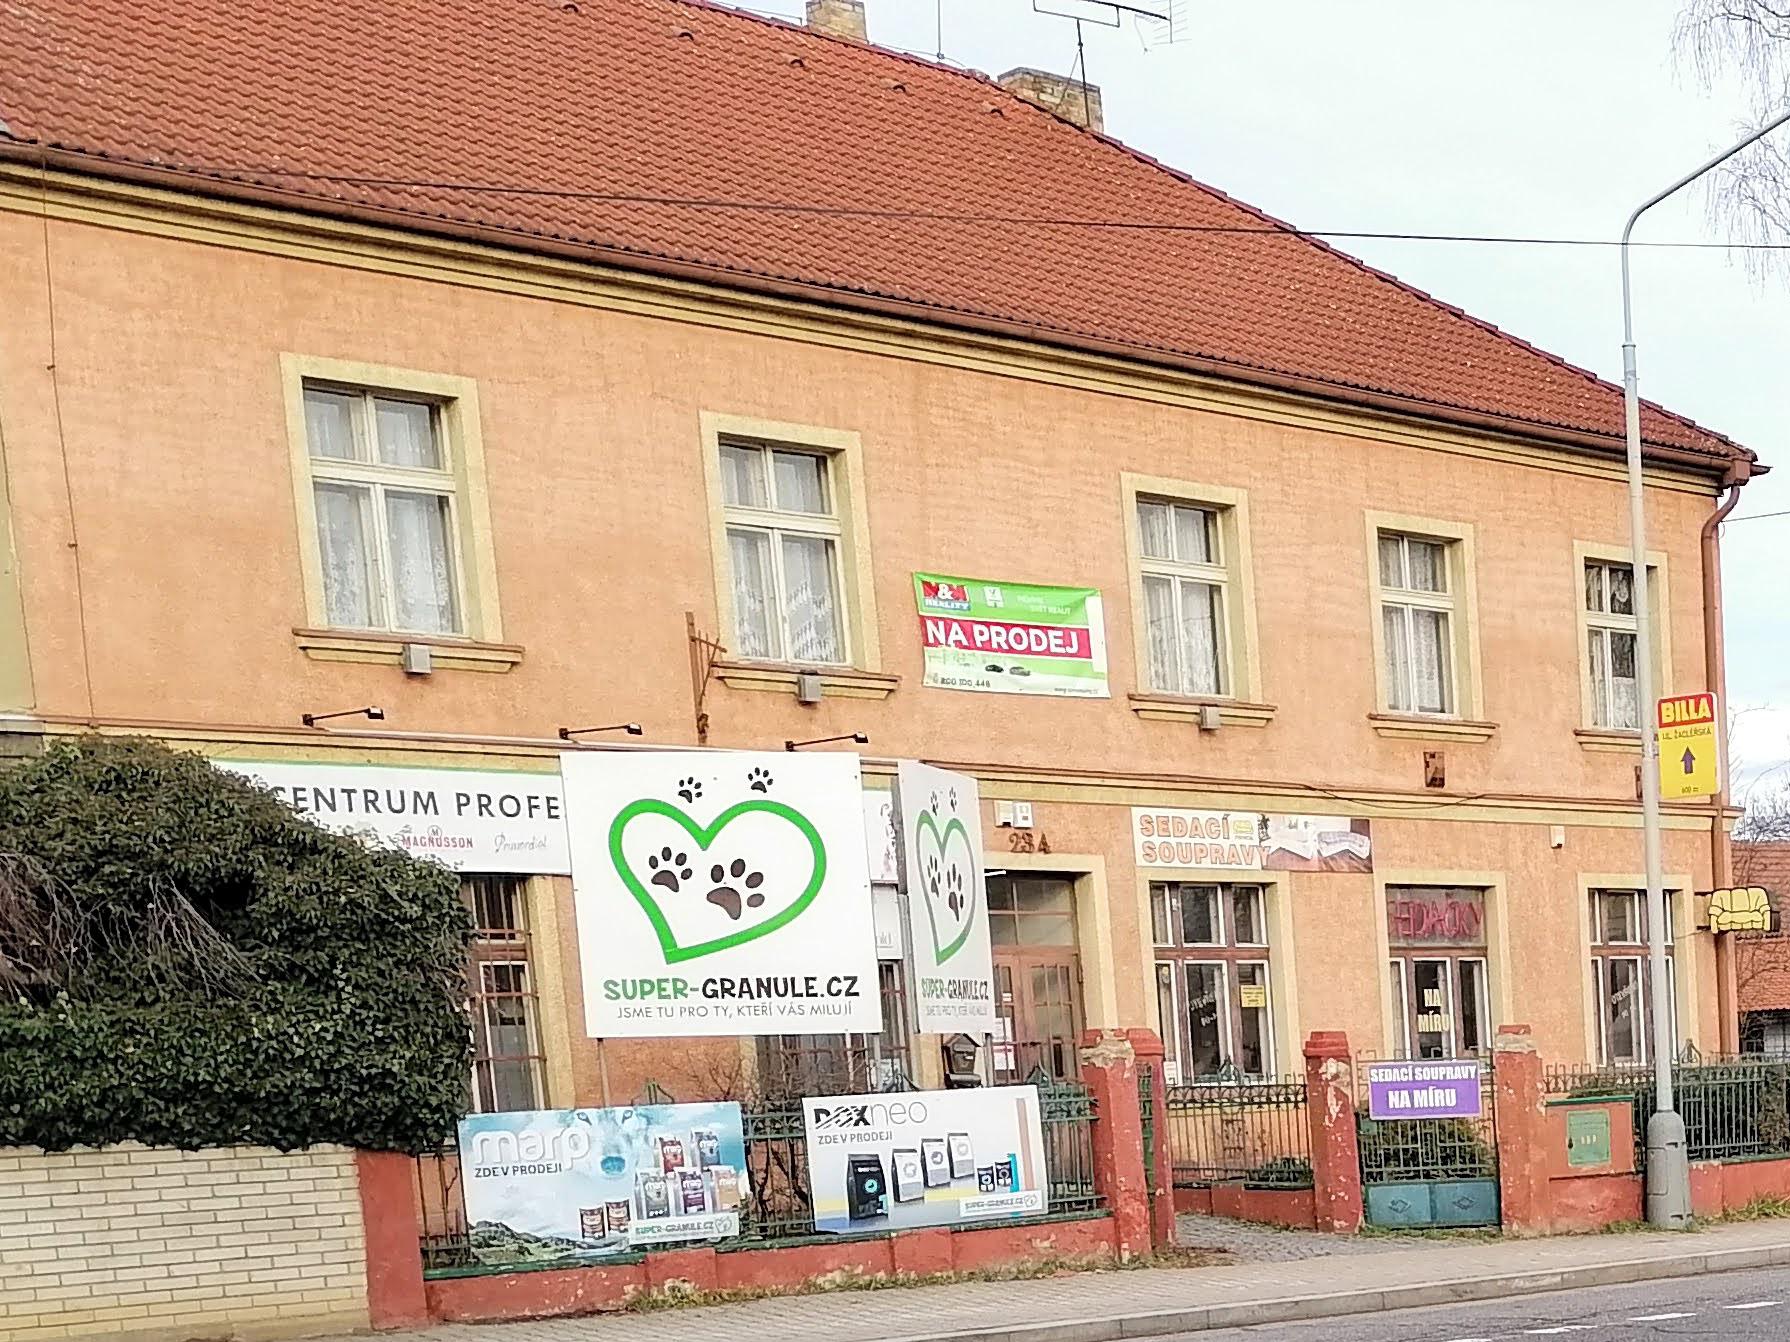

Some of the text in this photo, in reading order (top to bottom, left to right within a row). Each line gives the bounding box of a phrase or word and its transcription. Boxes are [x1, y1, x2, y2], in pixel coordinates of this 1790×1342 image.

[925, 619, 1078, 655] NA PRODEJ
[1661, 697, 1711, 723] BILLA
[456, 792, 560, 819] PROFE
[1140, 813, 1231, 840] SEDACÍ
[402, 834, 474, 850] MAGNUSSON
[1142, 840, 1272, 866] SOUPRAVY
[603, 976, 860, 1001] SUPER-GRANULE.CZ
[1424, 989, 1442, 1007] NA
[617, 1000, 852, 1019] JSME TU PRO TY, KTEŘÍ VÁS MILUJÍ
[1370, 1065, 1476, 1082] SEDACÍ SOUPRAVY
[1388, 1086, 1456, 1109] NA MÍRU
[472, 1127, 590, 1171] marp
[818, 1134, 838, 1144] ZDE
[850, 1130, 893, 1142] PRODEJI
[475, 1163, 562, 1178] ZDE V PRODEJI
